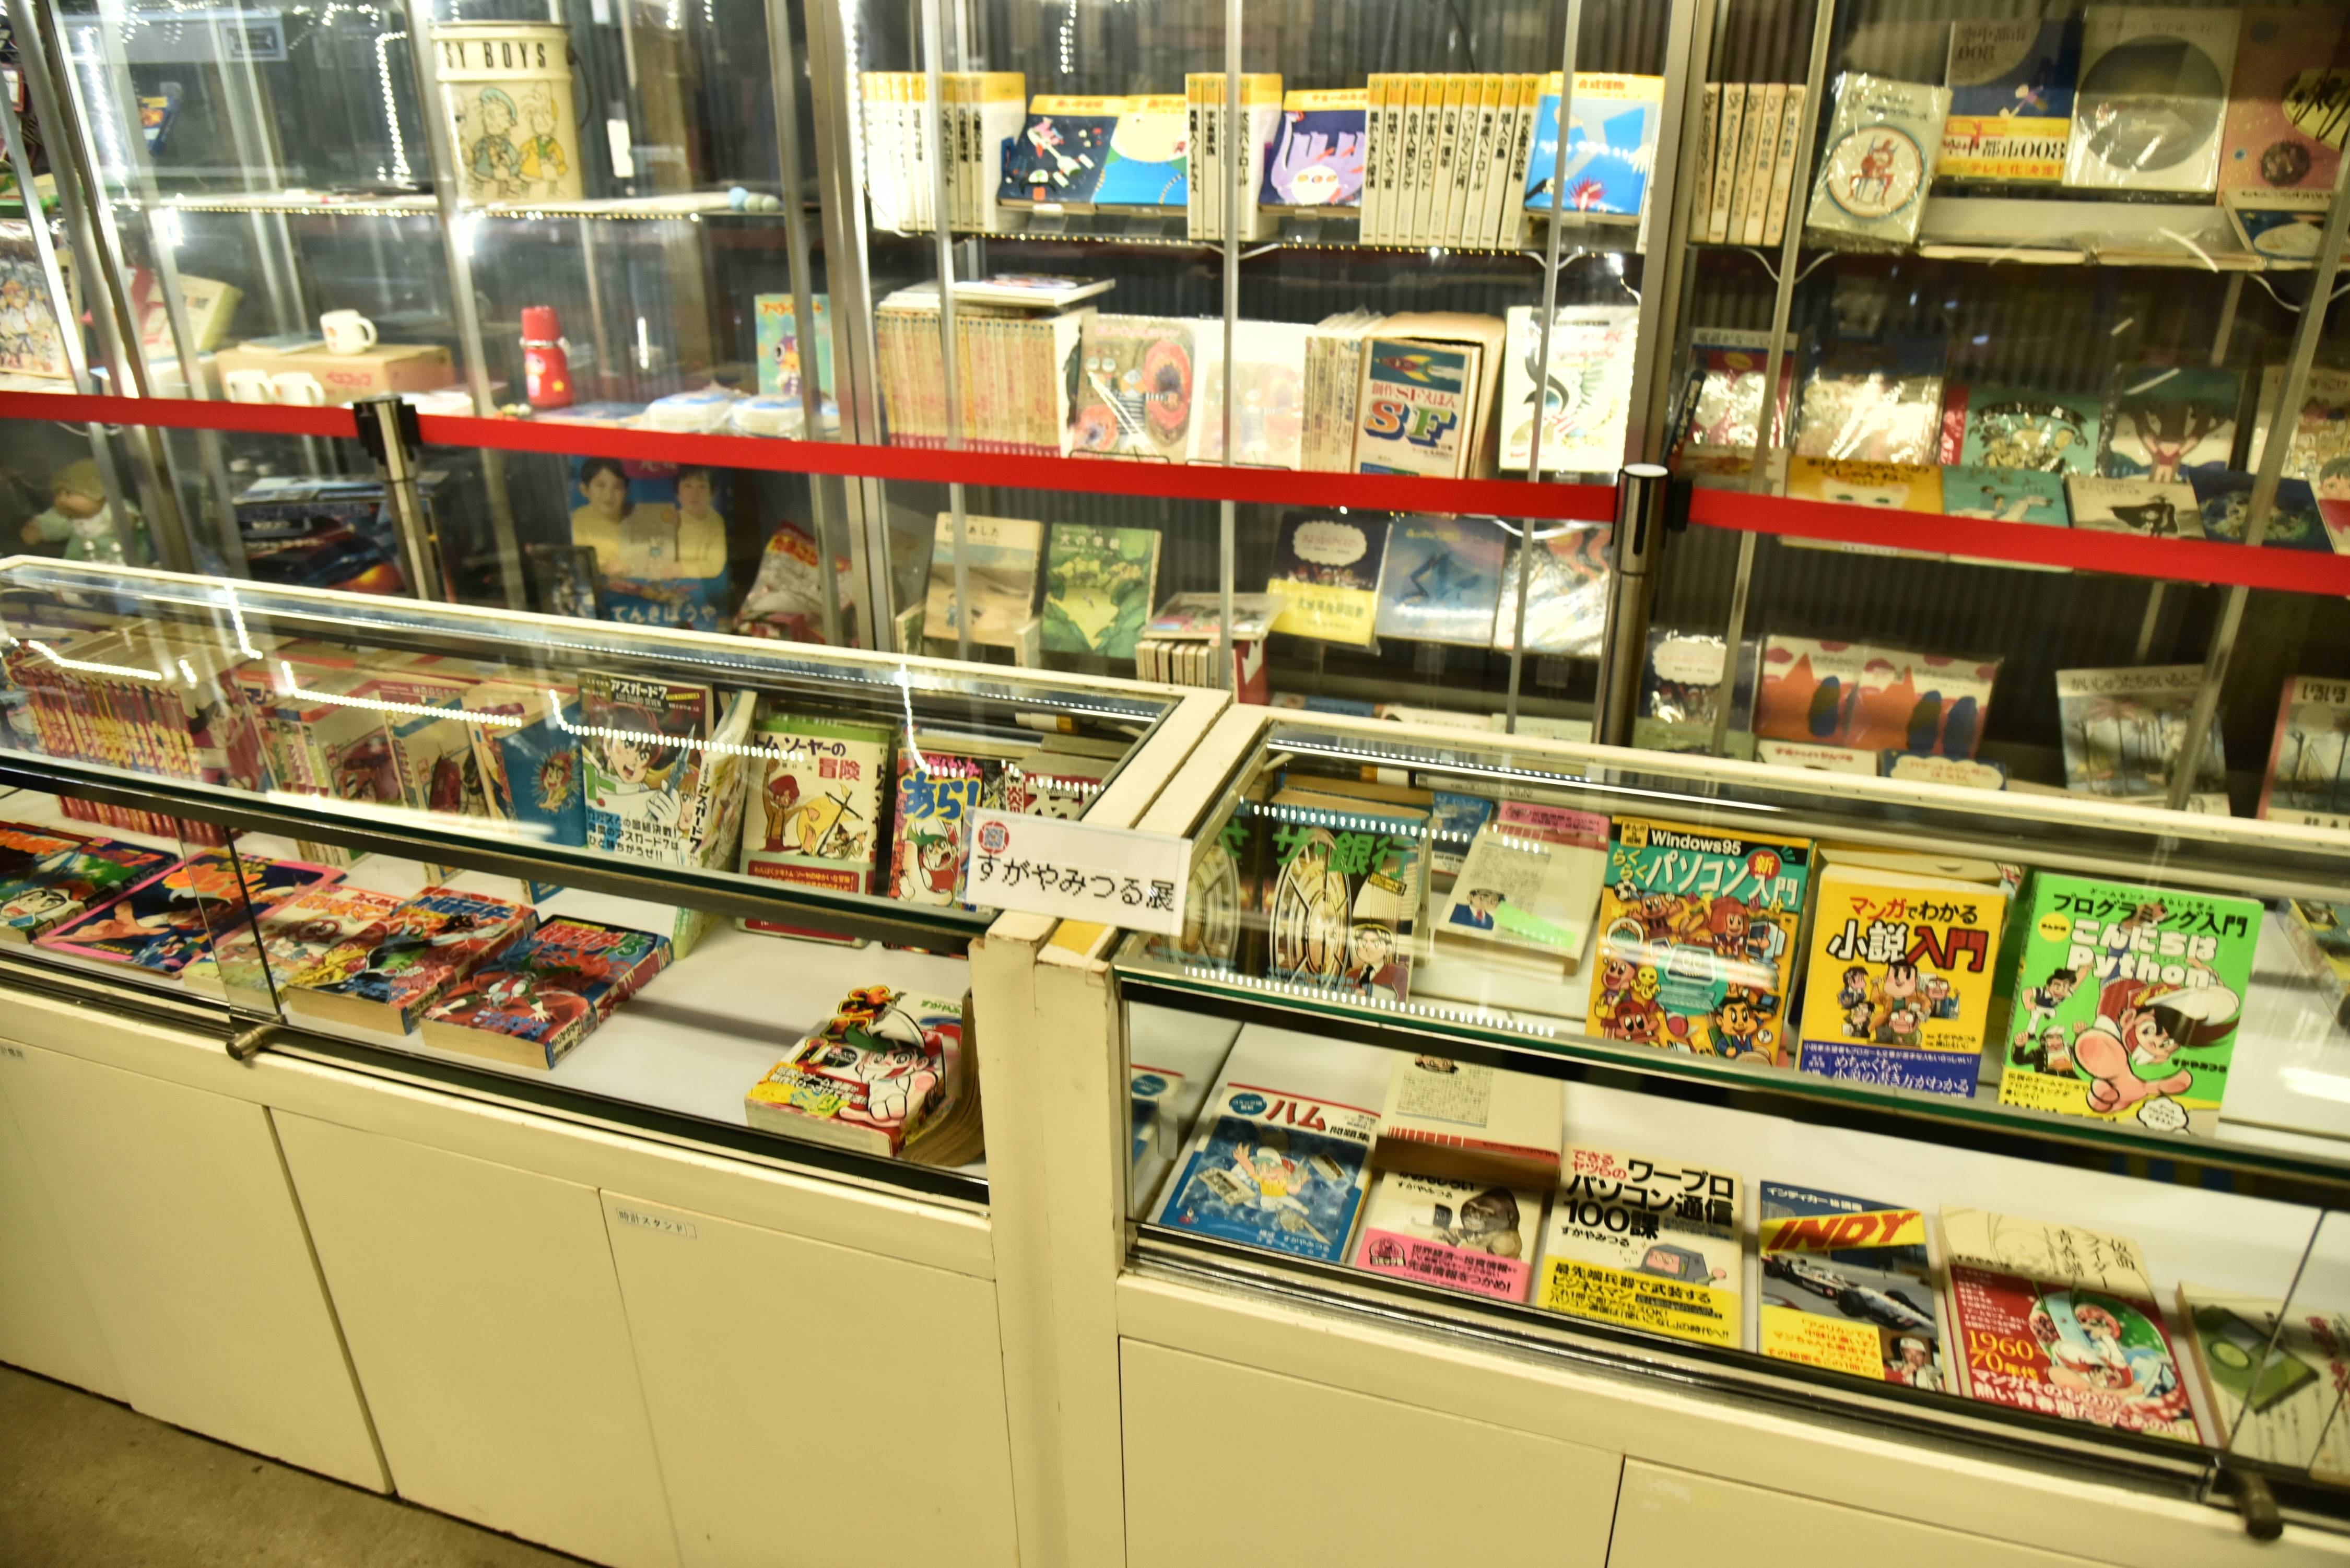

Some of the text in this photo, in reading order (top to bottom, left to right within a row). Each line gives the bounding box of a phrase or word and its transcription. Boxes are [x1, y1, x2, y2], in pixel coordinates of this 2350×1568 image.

[483, 41, 546, 68] BOYS
[1364, 398, 1458, 449] SF
[2071, 676, 2200, 691] かいじゅうたちのいるとこ
[818, 757, 861, 782] 冒険
[901, 769, 982, 823] あらし
[1273, 824, 1411, 878] ザ・銀行
[1651, 829, 1742, 856] Windows95
[977, 853, 1174, 912] すがやみつる展
[1754, 854, 1775, 875] 新
[1849, 895, 1978, 924] マンガでわかる
[2053, 893, 2248, 938] プログラミング入門
[1826, 918, 1989, 973] 小説入門
[2071, 917, 2218, 961] こんにちは
[2066, 943, 2211, 990] Python
[1265, 1099, 1326, 1131] ハム
[1572, 1149, 1615, 1166] できる
[1627, 1158, 1734, 1200] ワープロ
[1567, 1174, 1734, 1228] パソコン通信
[1560, 1225, 1630, 1248] すがやみつる
[1767, 1210, 1921, 1251] INDY
[1968, 1329, 2035, 1362] 1960
[1970, 1348, 2039, 1381] 70年代
